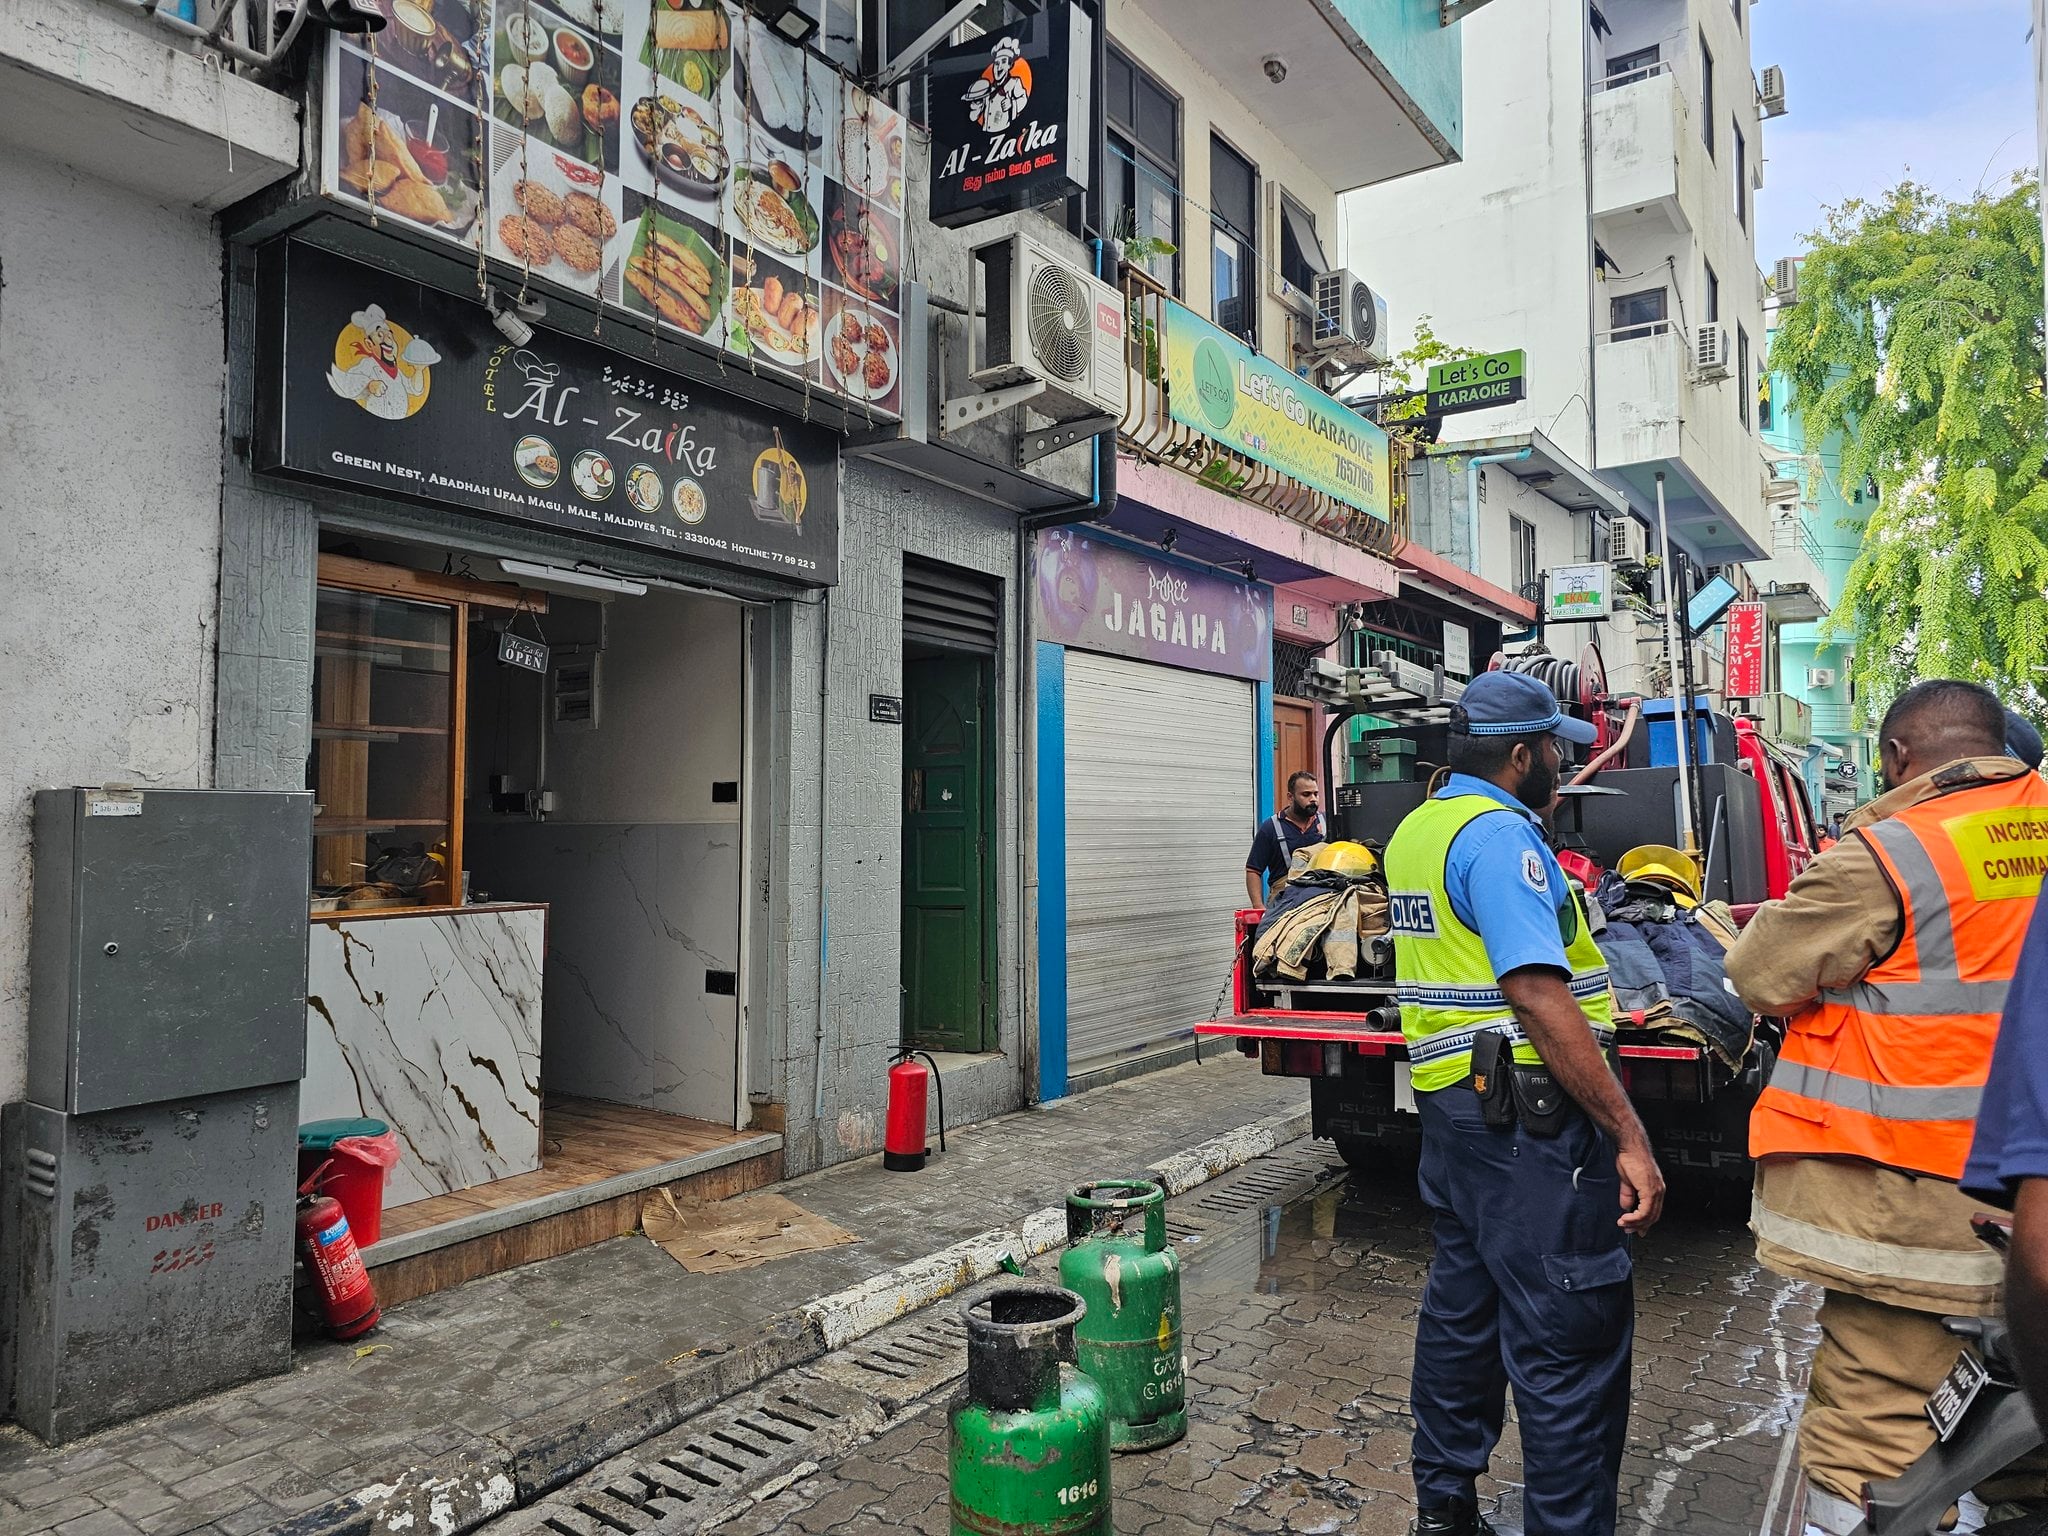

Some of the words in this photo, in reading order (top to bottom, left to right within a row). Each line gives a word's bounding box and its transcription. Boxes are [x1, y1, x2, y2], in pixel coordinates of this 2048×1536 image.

[1100, 311, 1118, 330] TCL
[484, 345, 515, 412] HOTEL
[1440, 364, 1478, 386] Let's
[1484, 359, 1510, 377] Go
[1439, 382, 1511, 407] KARAOKE
[1239, 359, 1281, 411] Let's
[1282, 386, 1306, 426] Go
[1308, 408, 1373, 464] KARAOKE
[684, 532, 727, 550] 3330042
[1565, 592, 1590, 604] EKAZ
[1105, 592, 1226, 655] JAGAHA
[505, 648, 542, 669] OPEN
[1730, 613, 1742, 697] PHARMACY
[1933, 1379, 1961, 1422] P1763
[1057, 1479, 1098, 1505] 1616
